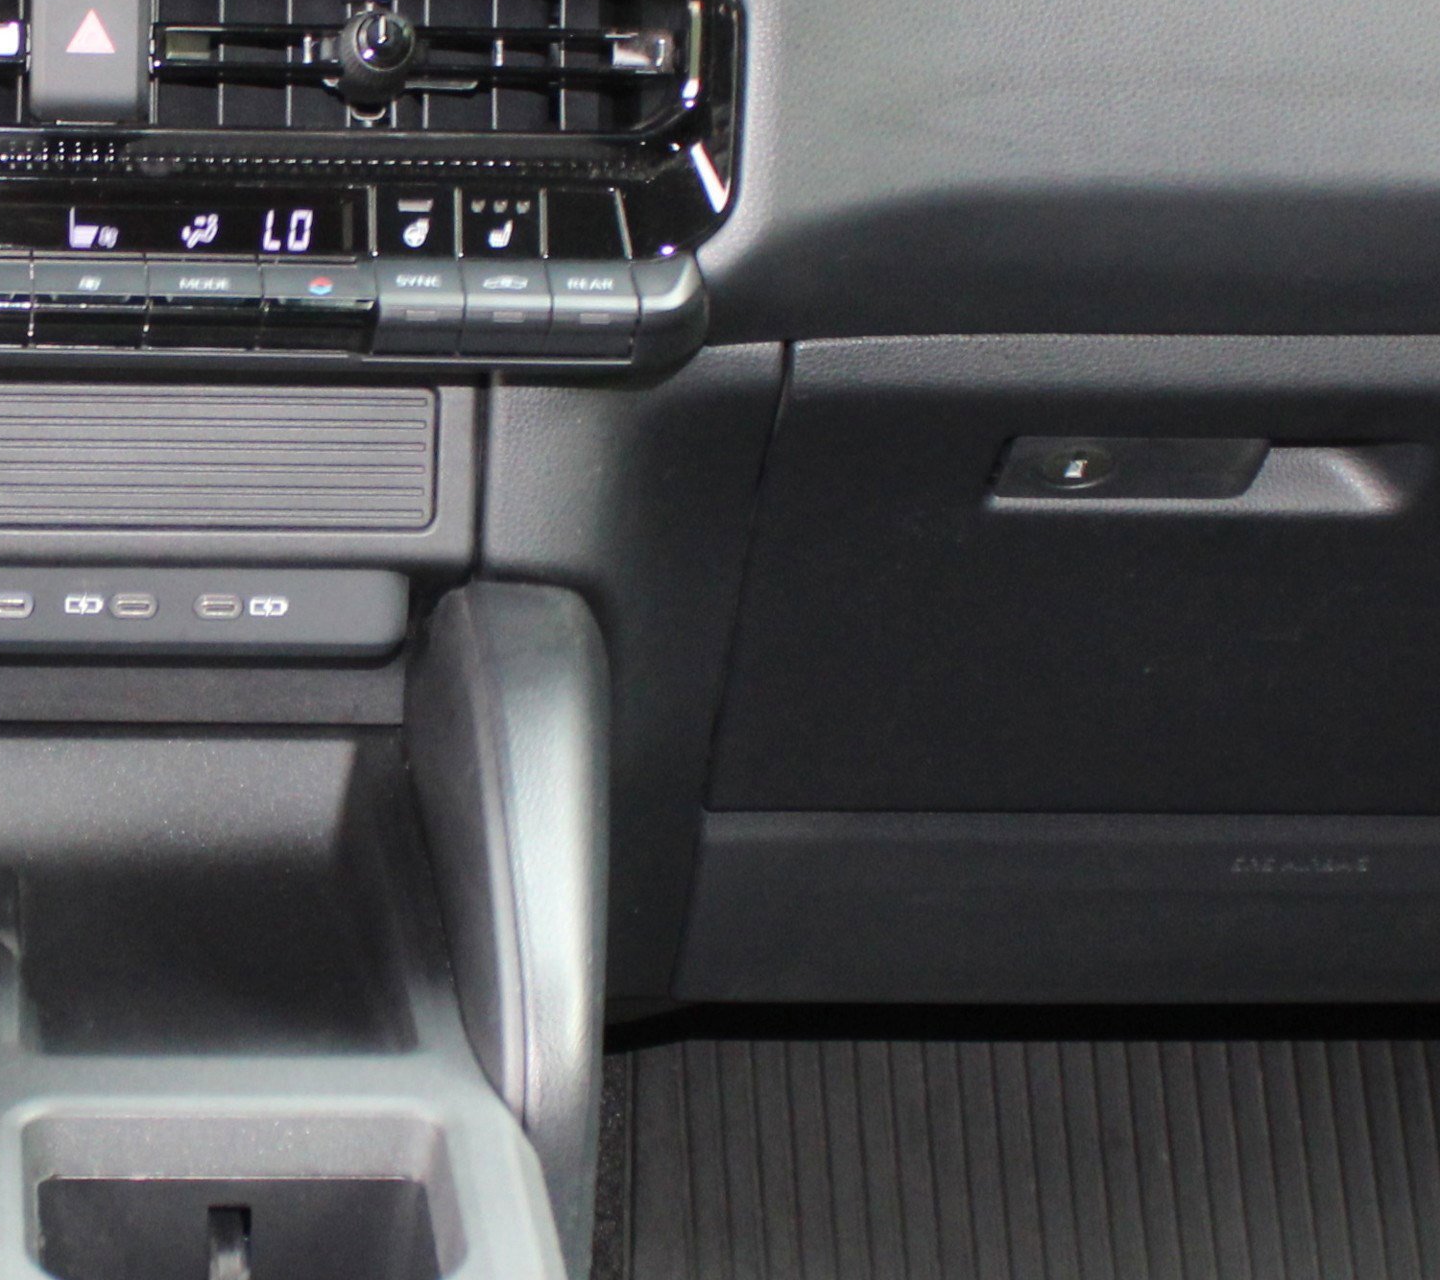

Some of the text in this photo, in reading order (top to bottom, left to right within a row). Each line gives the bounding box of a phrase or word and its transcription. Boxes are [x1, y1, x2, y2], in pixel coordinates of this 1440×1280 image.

[262, 208, 314, 252] LO
[395, 273, 443, 289] SYNC
[566, 276, 615, 291] REAR
